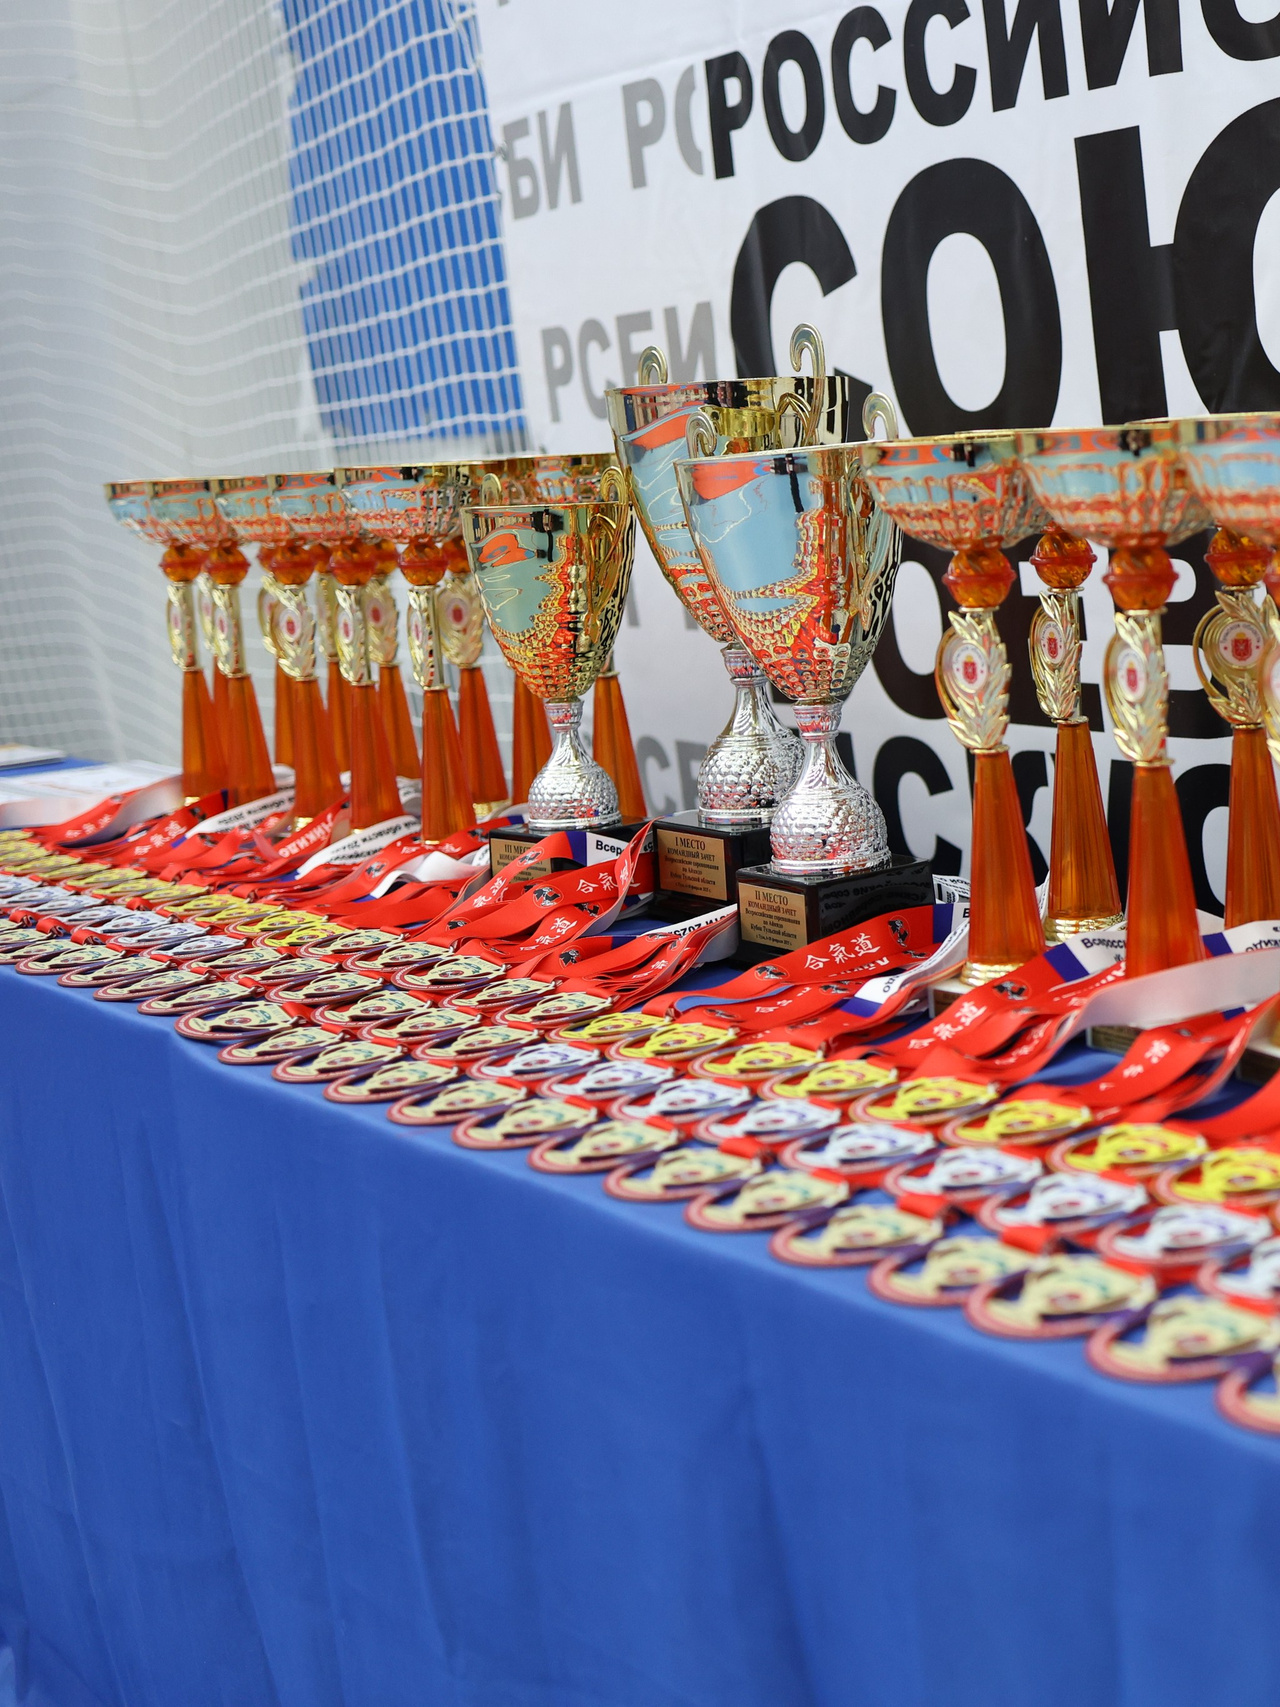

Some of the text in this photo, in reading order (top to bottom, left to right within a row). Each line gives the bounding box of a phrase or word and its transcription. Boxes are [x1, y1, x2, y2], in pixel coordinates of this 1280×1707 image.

[595, 840, 623, 858] Всер
[679, 837, 706, 851] МЕСТО
[761, 892, 789, 906] МЕСТО
